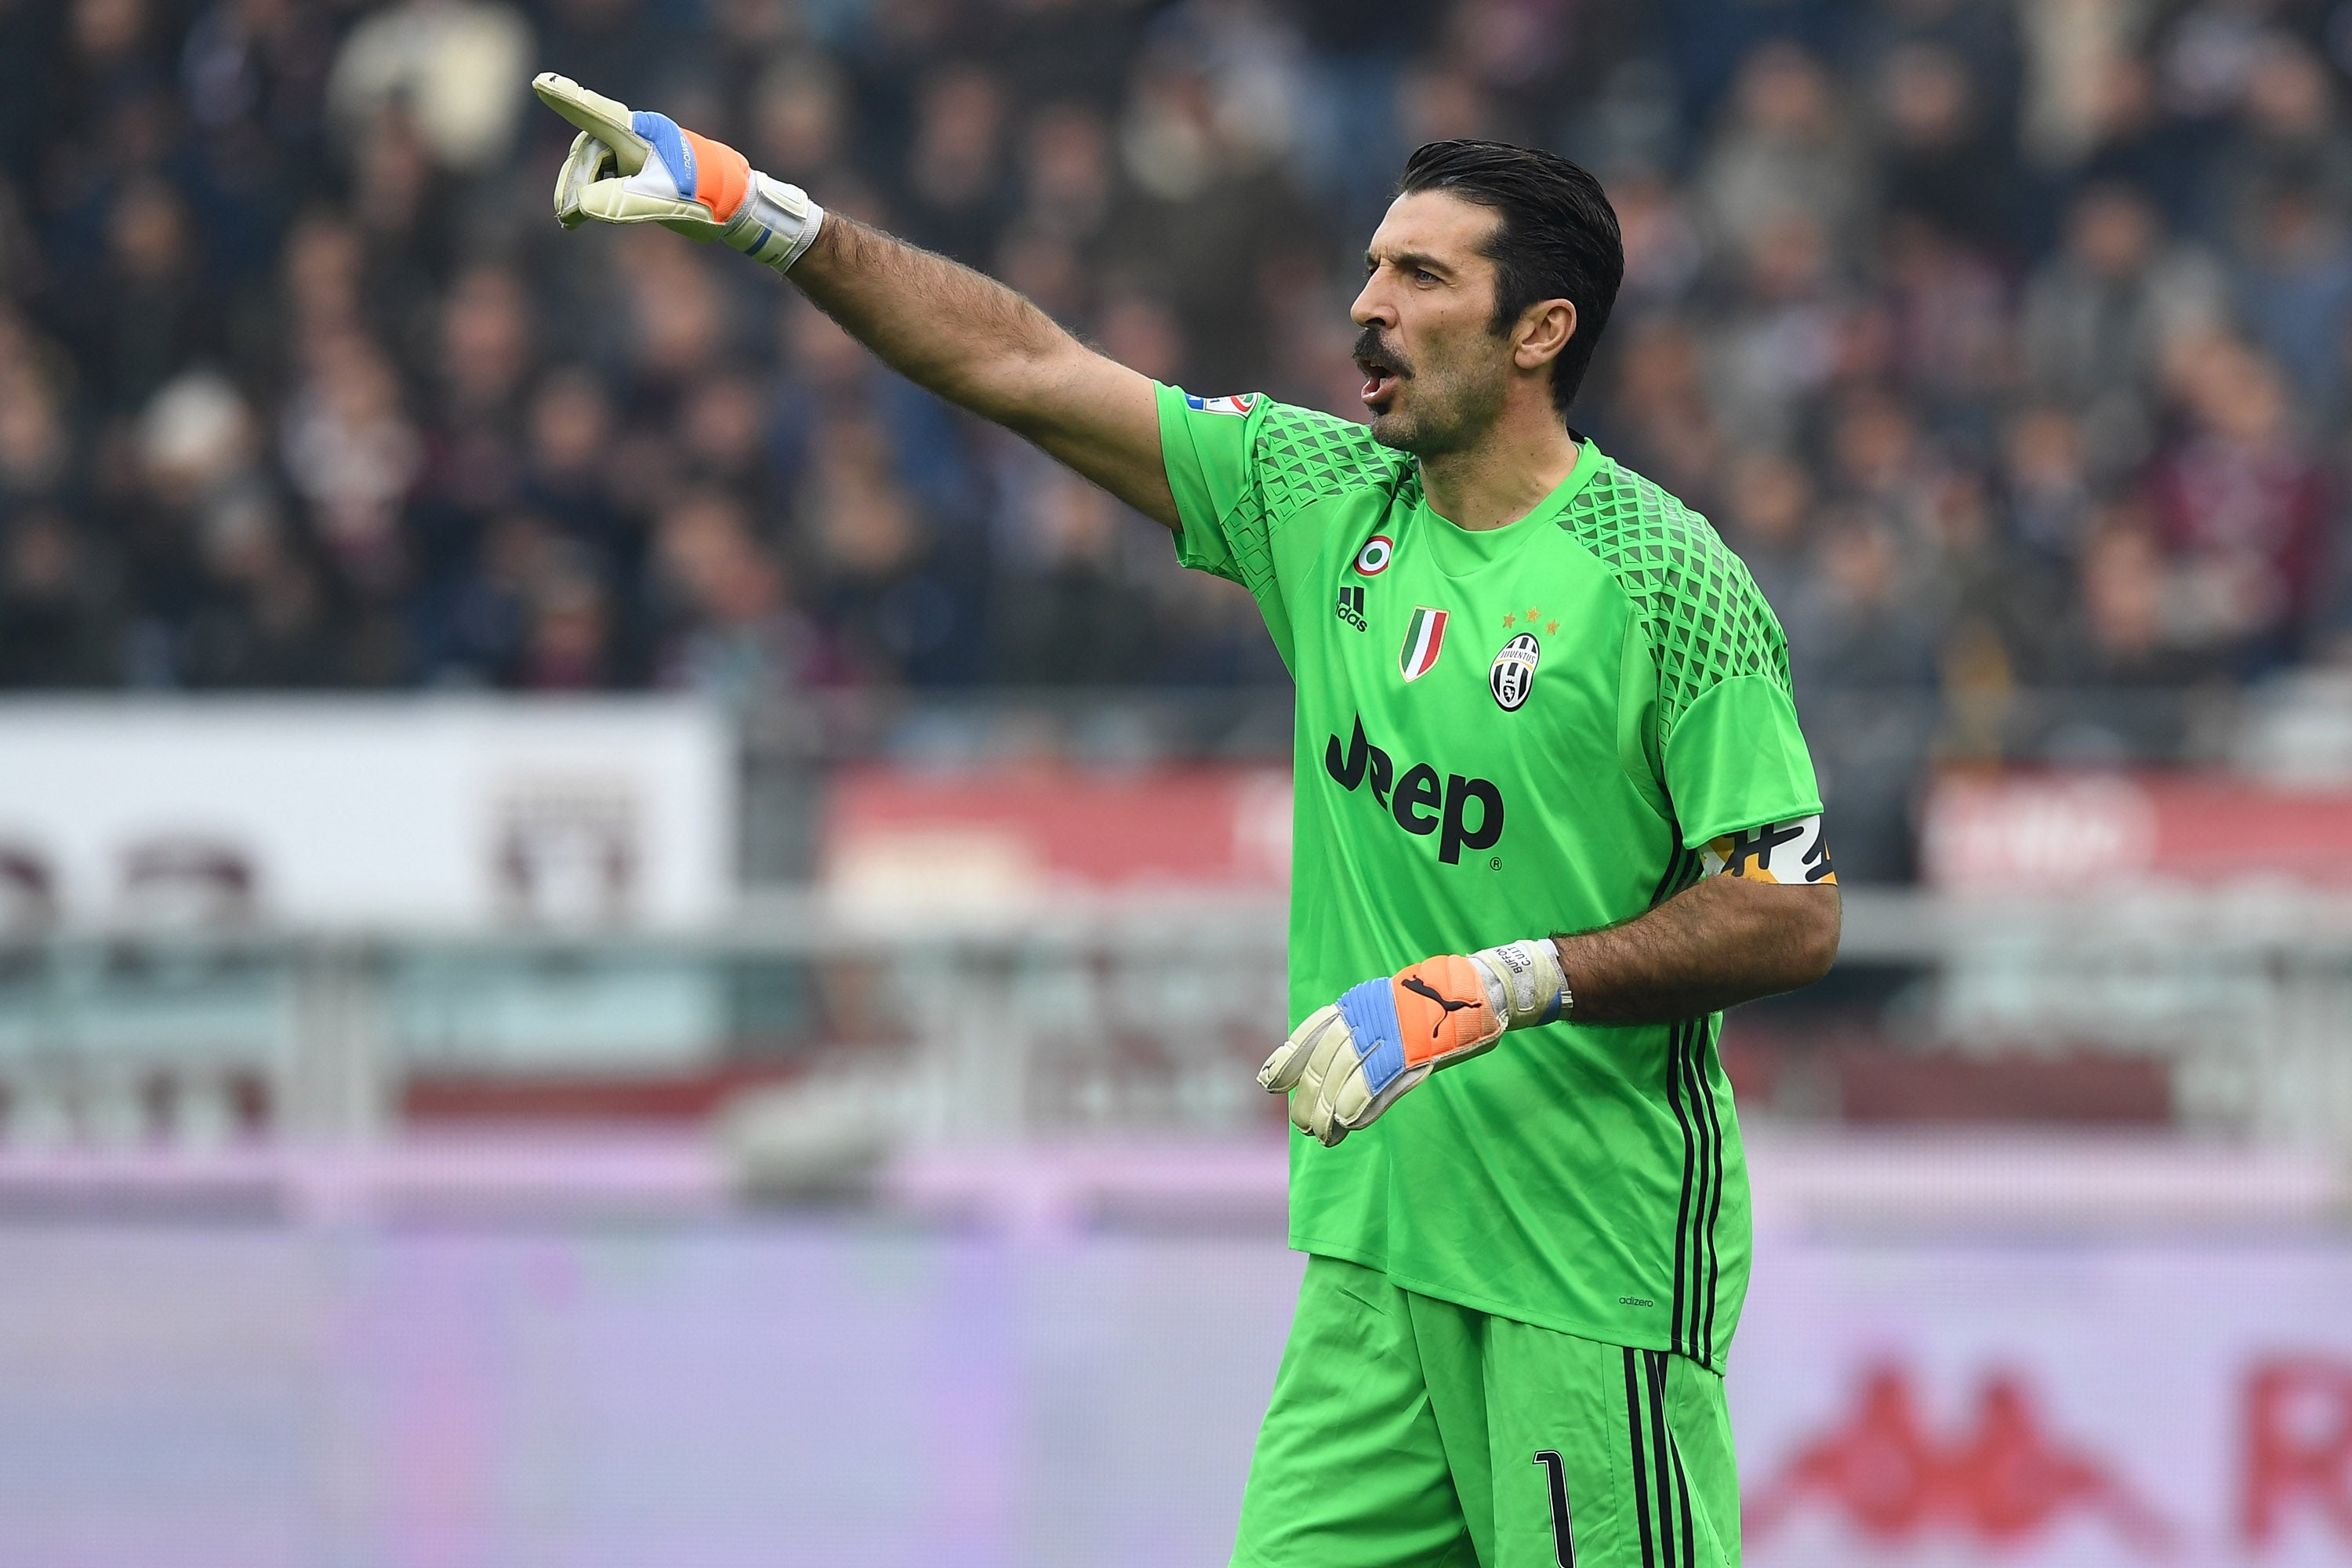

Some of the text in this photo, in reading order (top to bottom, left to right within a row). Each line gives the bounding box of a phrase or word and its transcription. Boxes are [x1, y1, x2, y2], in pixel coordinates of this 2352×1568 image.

[1334, 599, 1368, 633] idas
[1500, 650, 1536, 665] JUVENTUS
[1325, 710, 1504, 866] Jeep
[1493, 948, 1523, 974] BUFFON
[1618, 1296, 1654, 1308] adizero
[1532, 1450, 1577, 1568] 1
